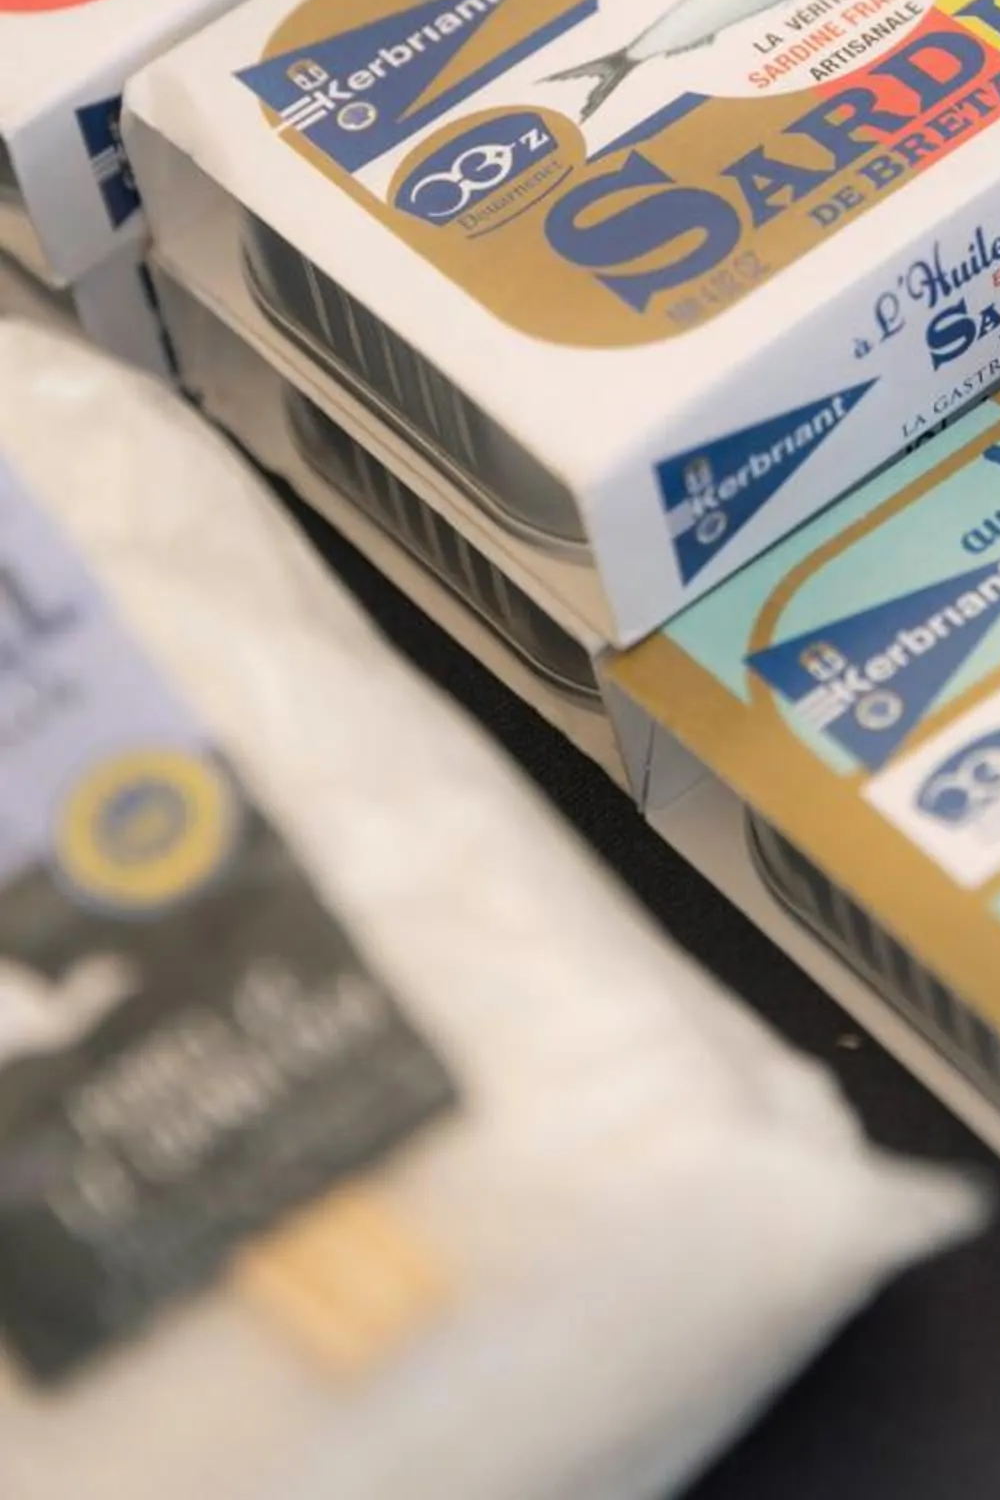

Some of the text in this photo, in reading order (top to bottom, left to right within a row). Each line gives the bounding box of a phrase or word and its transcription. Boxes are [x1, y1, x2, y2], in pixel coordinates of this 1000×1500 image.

[748, 18, 849, 90] SARDINE
[752, 32, 785, 56] LA
[808, 0, 925, 83] ARTISANALE
[809, 184, 864, 230] DE
[852, 336, 874, 361] à
[901, 415, 929, 439] LA
[688, 396, 847, 515] Kerbriant
